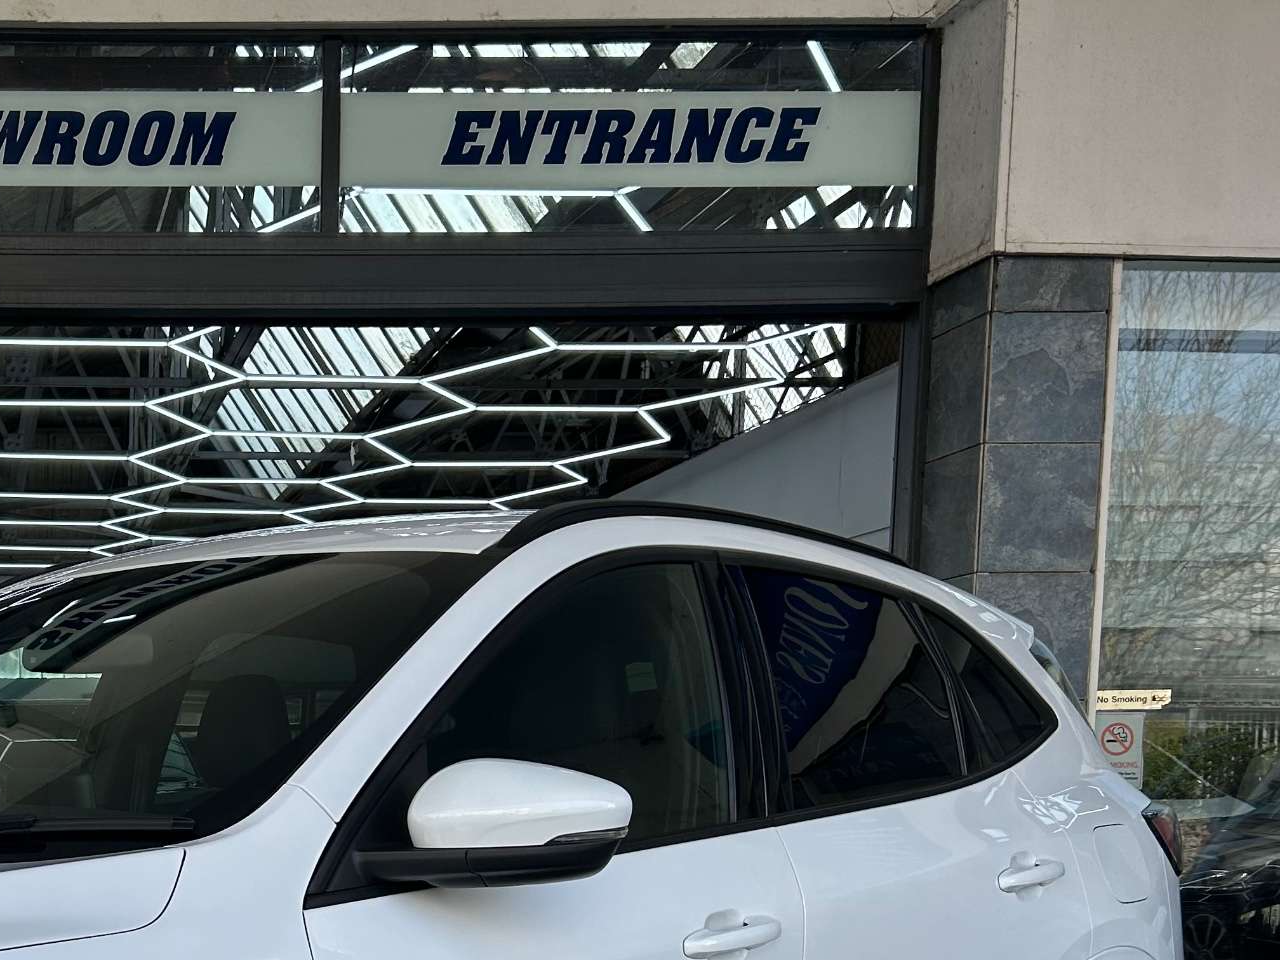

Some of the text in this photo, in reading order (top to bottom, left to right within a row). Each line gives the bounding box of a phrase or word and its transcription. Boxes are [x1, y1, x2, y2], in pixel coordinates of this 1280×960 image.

[440, 106, 822, 166] ENTRANCE
[1097, 695, 1148, 705] No Smoking
